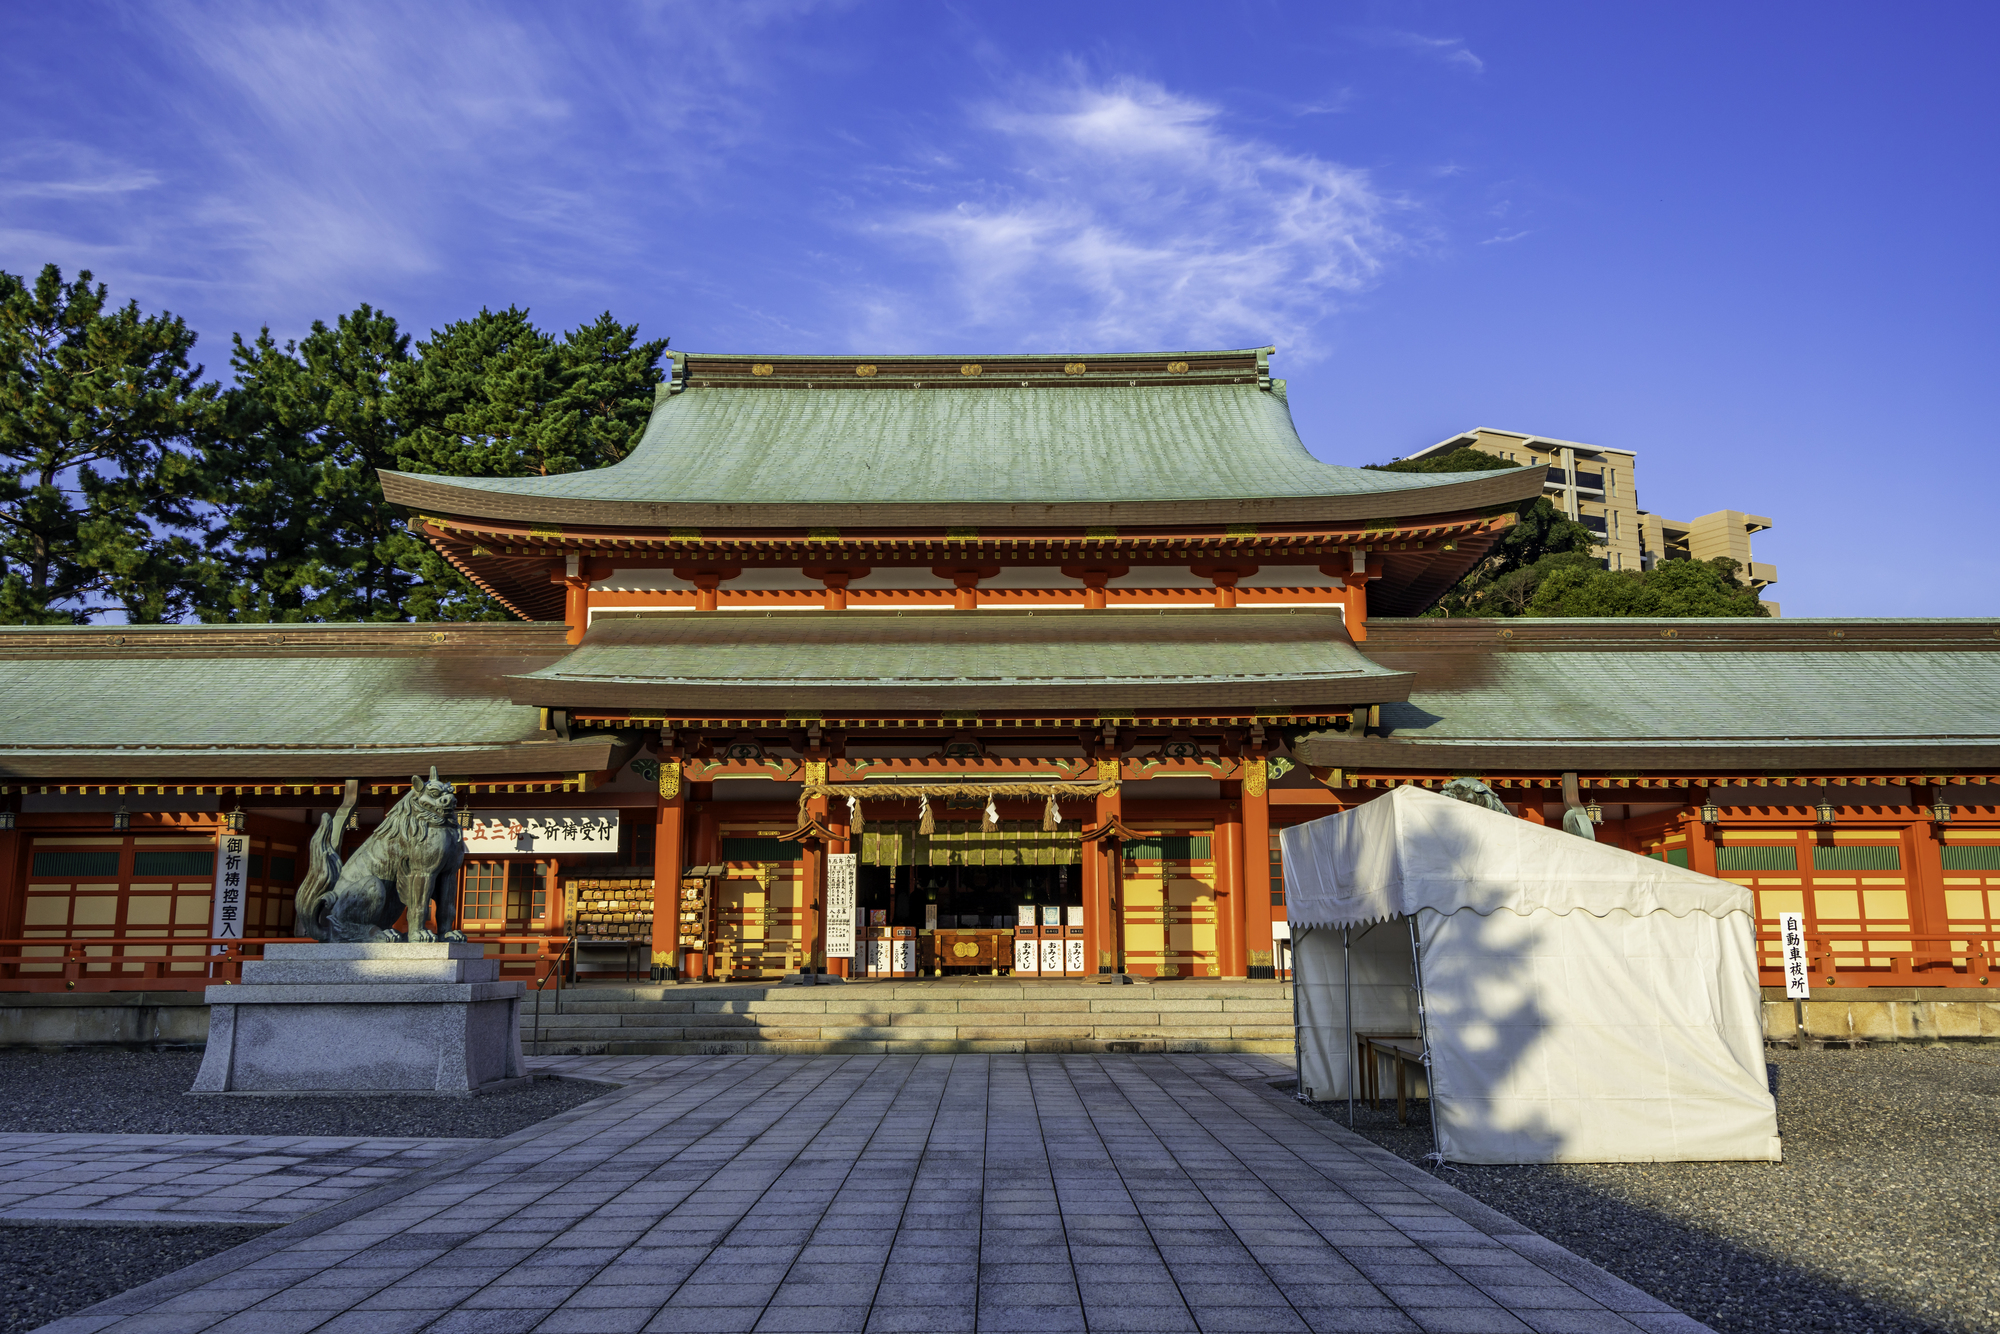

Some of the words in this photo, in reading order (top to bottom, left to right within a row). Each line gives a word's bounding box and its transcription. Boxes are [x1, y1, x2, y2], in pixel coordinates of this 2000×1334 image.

[875, 943, 883, 970] おみくじ
[900, 943, 909, 970] おみくじ
[1022, 942, 1031, 970] おみくじ
[1047, 942, 1056, 970] おみくじ
[1072, 942, 1082, 970] おみくじ
[1786, 916, 1805, 993] 自動車祓所
